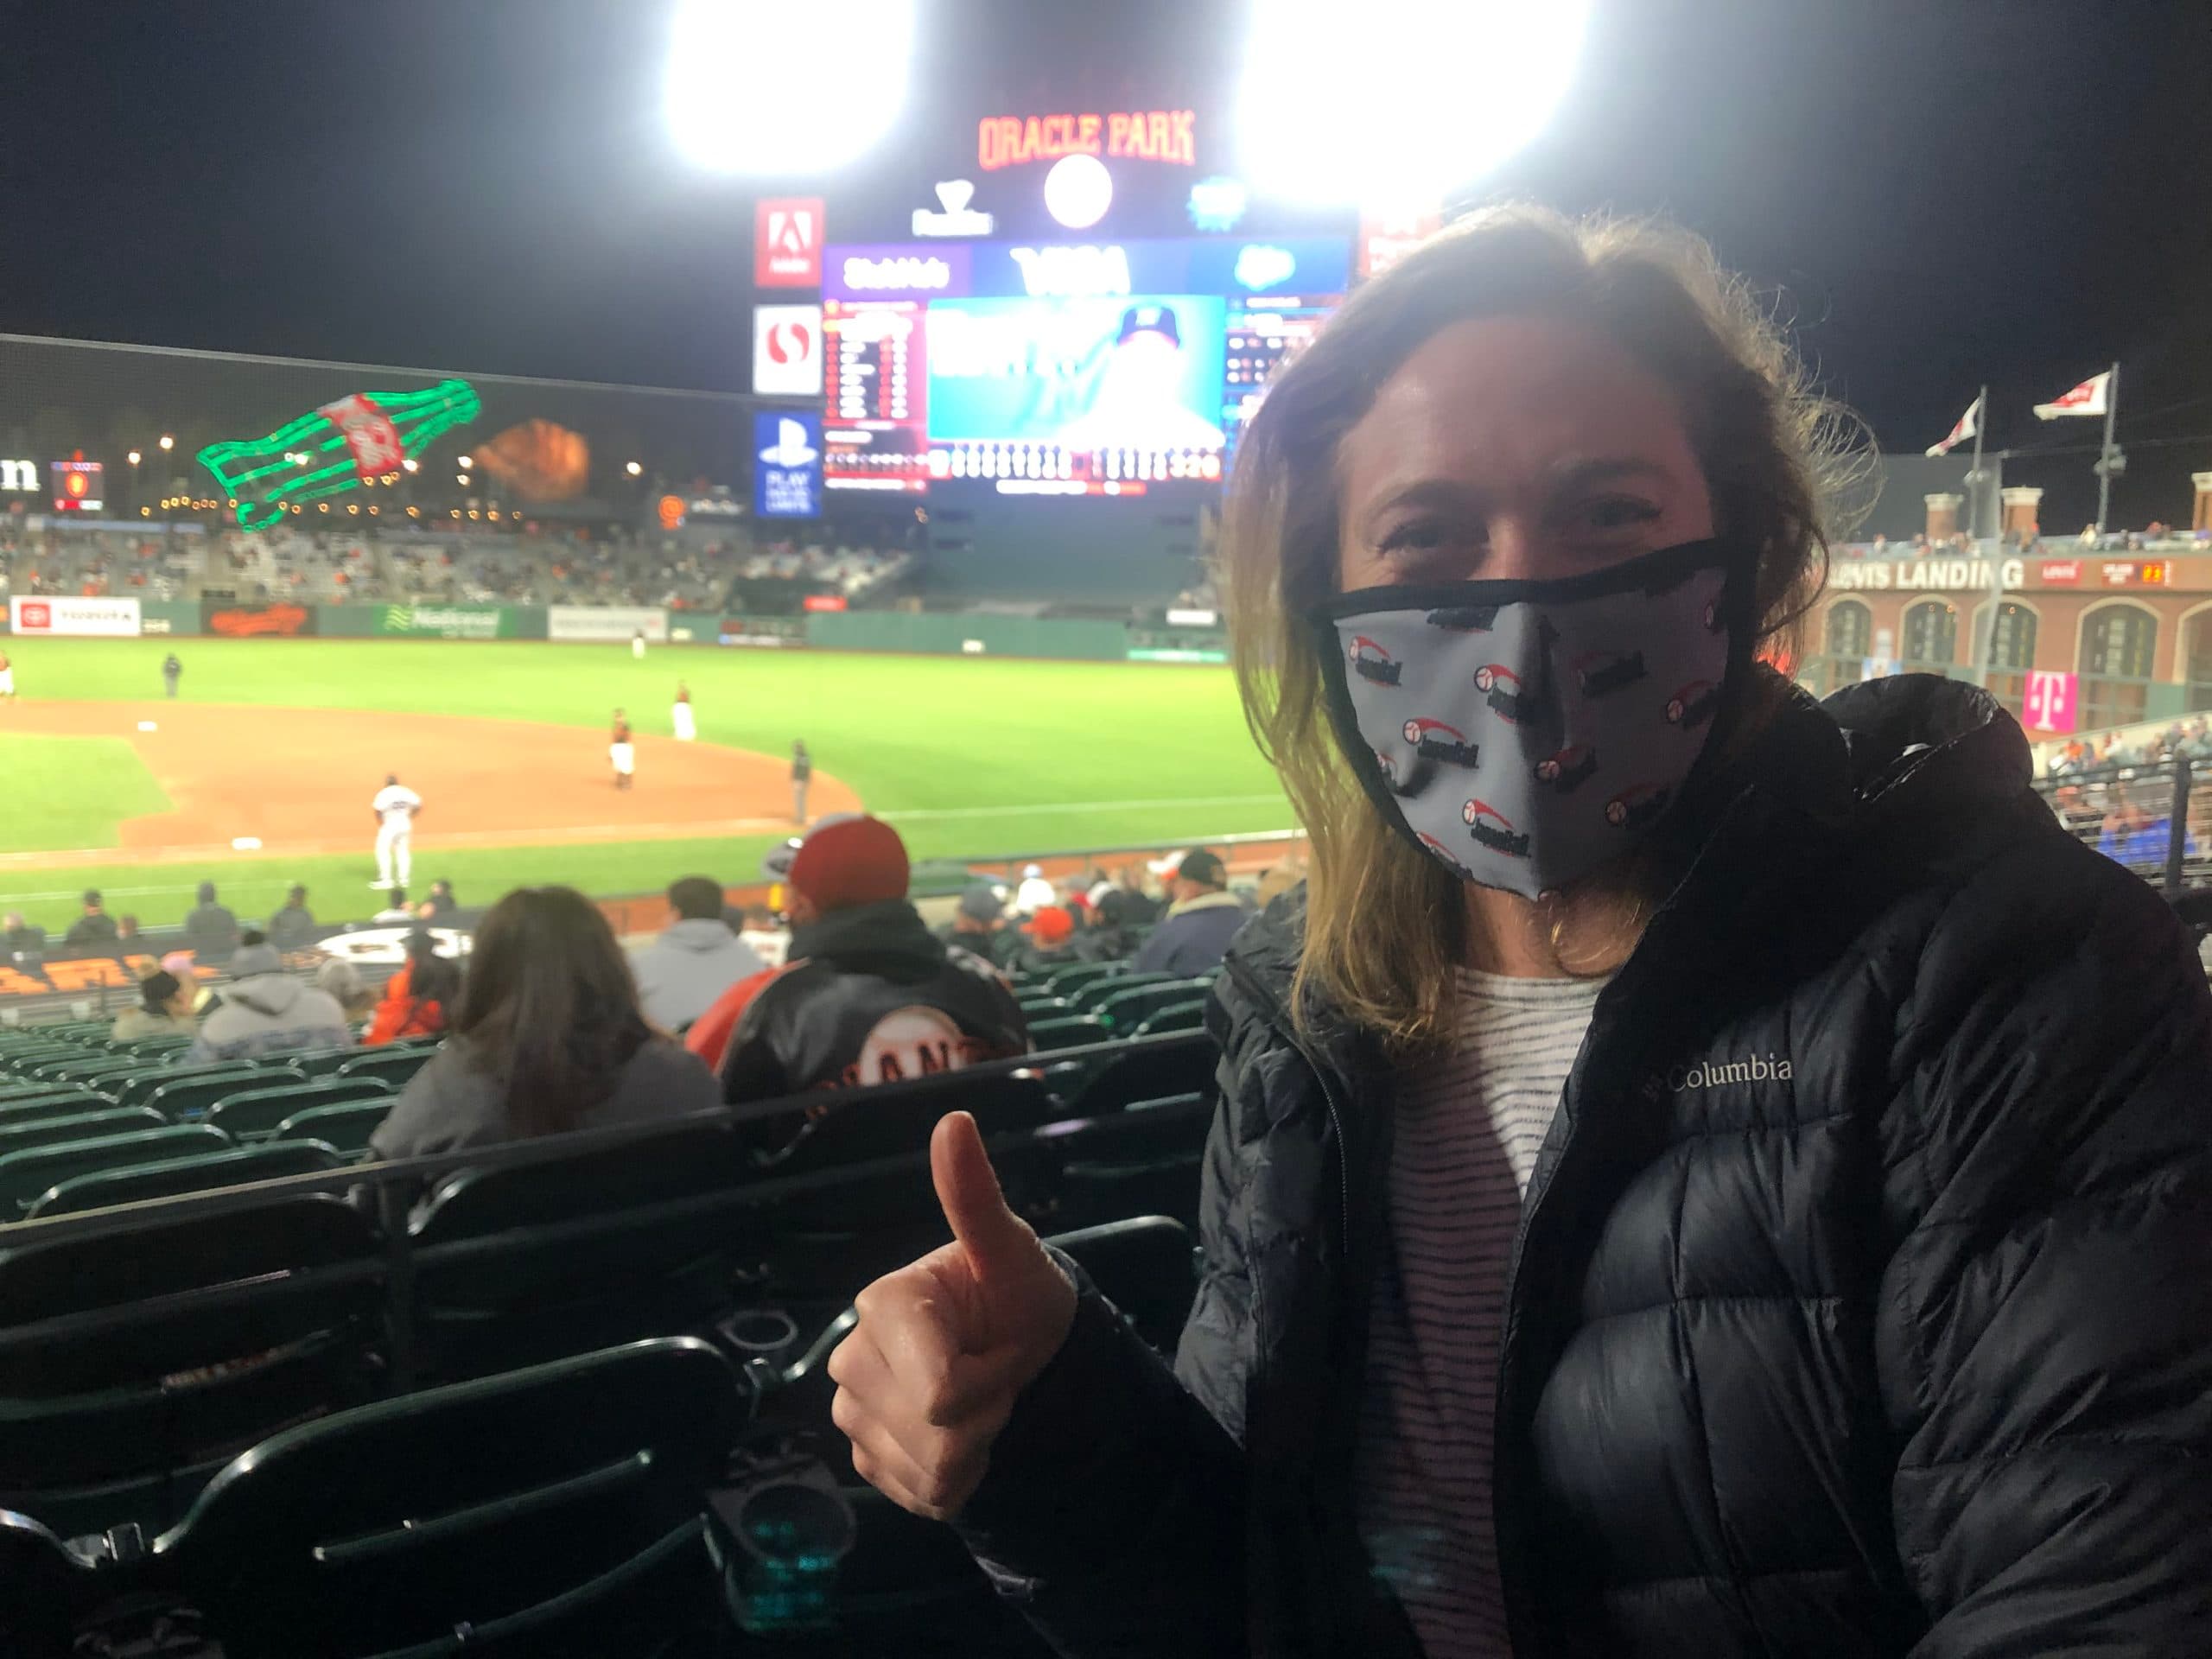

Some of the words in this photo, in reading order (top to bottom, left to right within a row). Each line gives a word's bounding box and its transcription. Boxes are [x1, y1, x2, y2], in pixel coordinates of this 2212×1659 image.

[979, 114, 1102, 171] ORACLE
[1108, 111, 1195, 166] PARK
[1896, 559, 2024, 590] LANDING
[1668, 1052, 1793, 1092] Columbia
